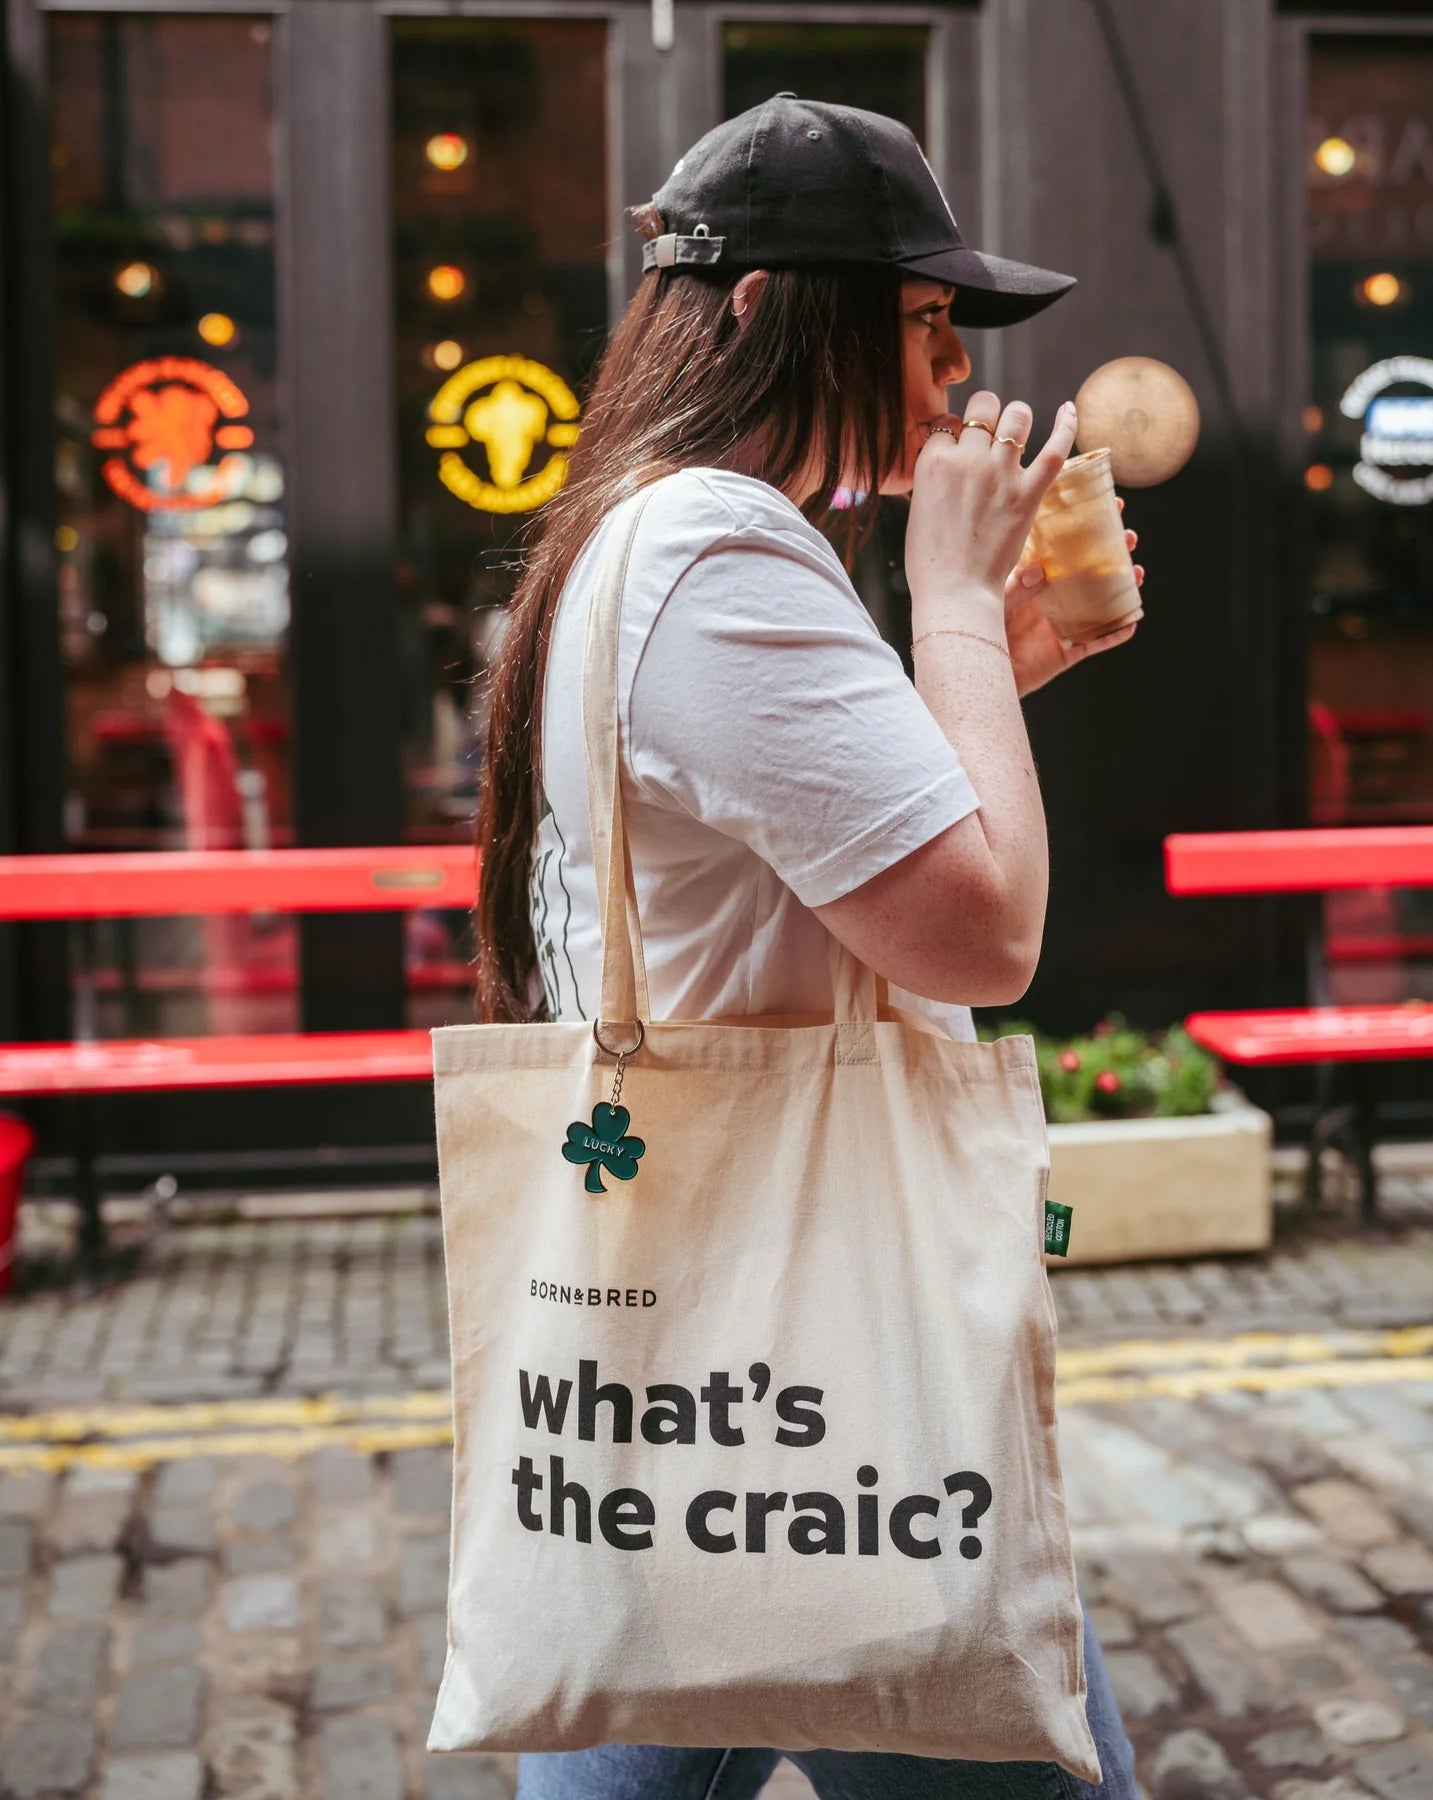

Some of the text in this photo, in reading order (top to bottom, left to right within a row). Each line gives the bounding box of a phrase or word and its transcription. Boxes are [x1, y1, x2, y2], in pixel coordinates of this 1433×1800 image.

[583, 1136, 625, 1157] LUCKY
[1045, 1213, 1055, 1241] RECYCLED
[1055, 1218, 1065, 1241] COTTON
[530, 1279, 657, 1308] BORN&BRED
[519, 1359, 826, 1448] what's
[511, 1454, 993, 1560] the craic?
